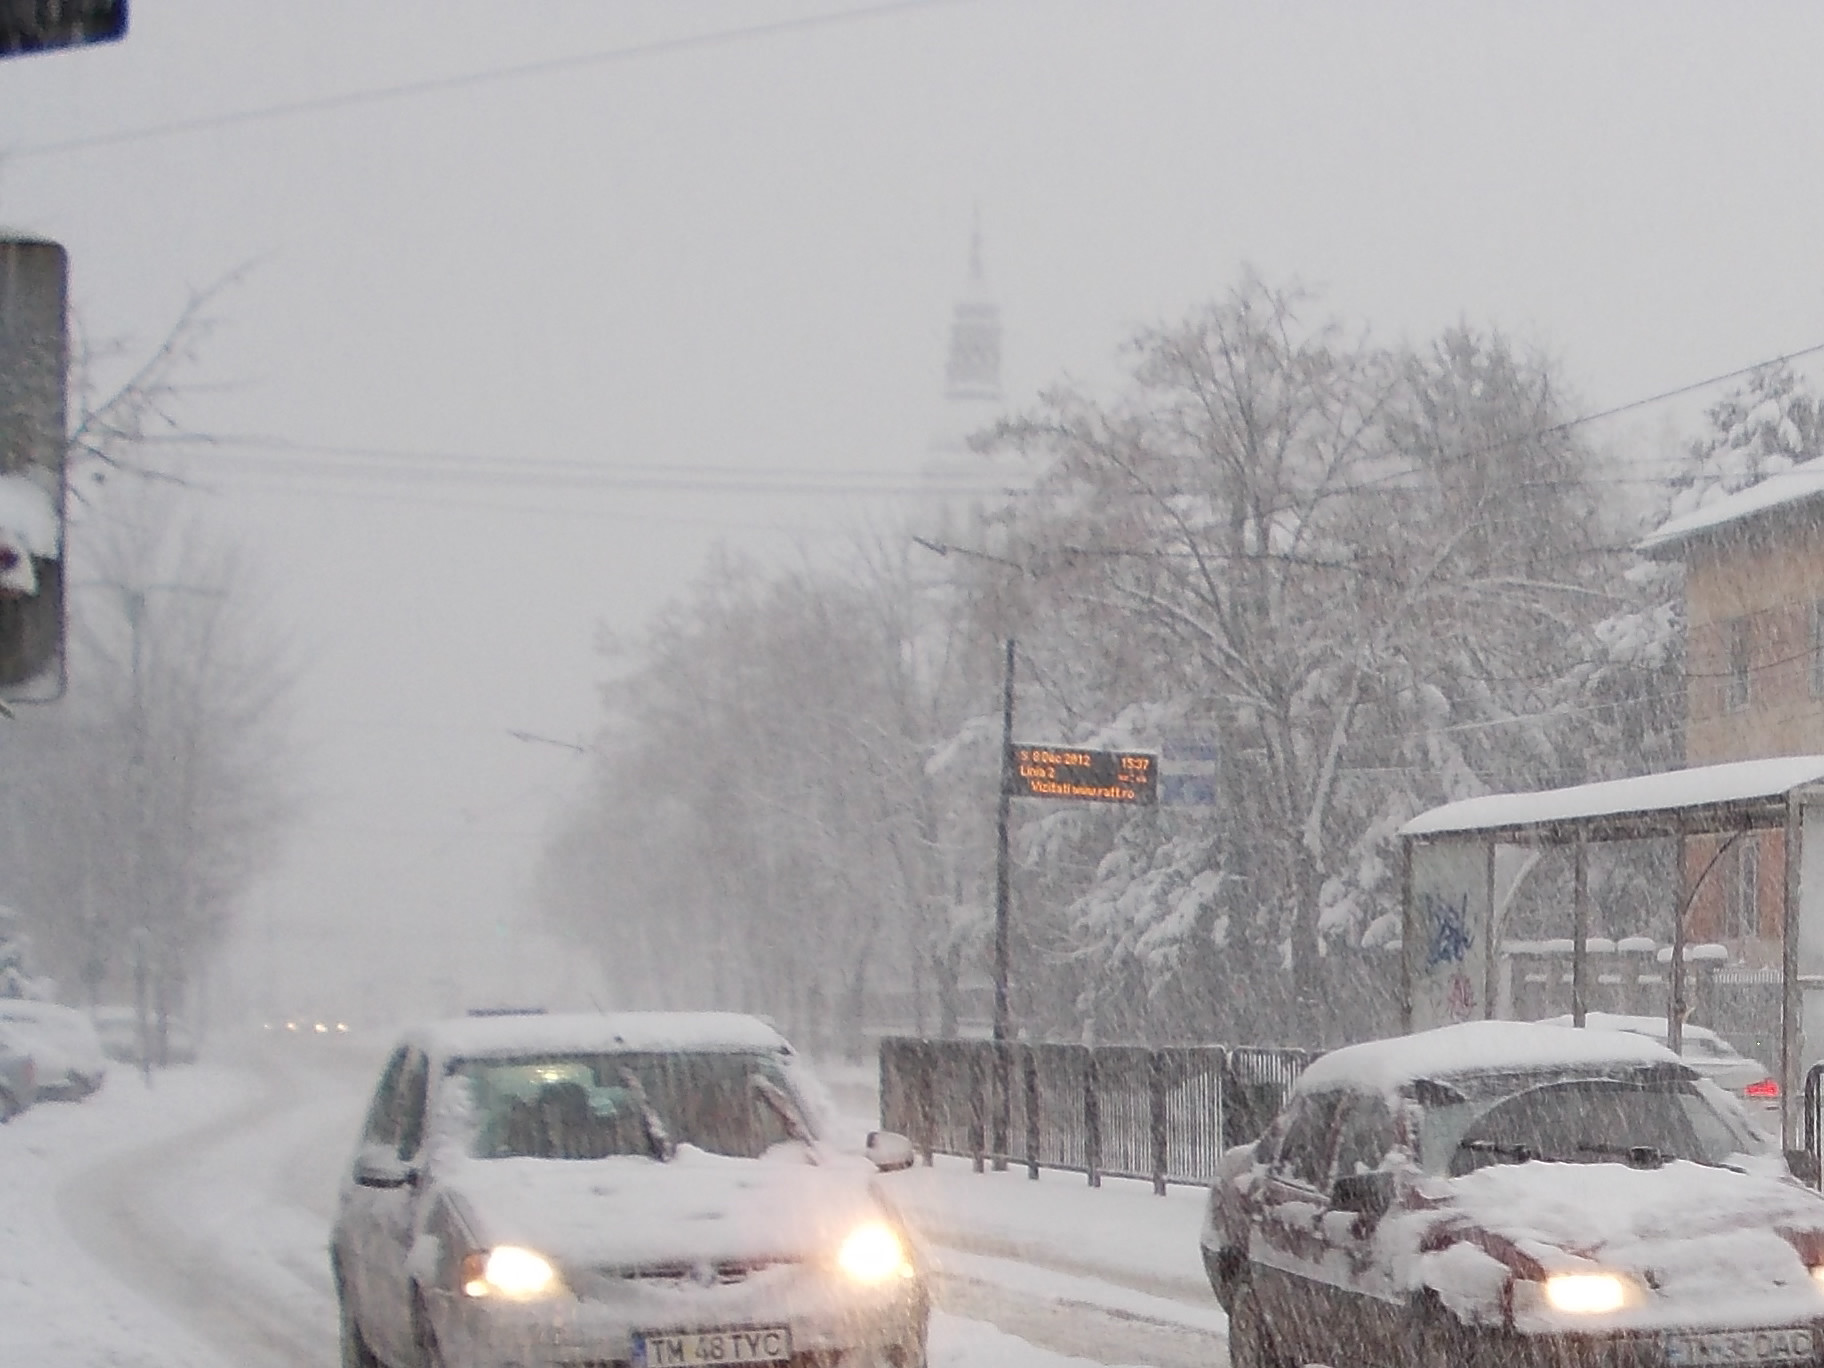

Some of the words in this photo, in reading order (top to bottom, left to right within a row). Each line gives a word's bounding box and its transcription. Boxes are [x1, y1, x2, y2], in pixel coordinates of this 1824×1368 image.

[1064, 753, 1091, 767] 2012
[651, 1339, 685, 1364] TM
[695, 1336, 725, 1360] 48
[731, 1332, 780, 1358] TYC
